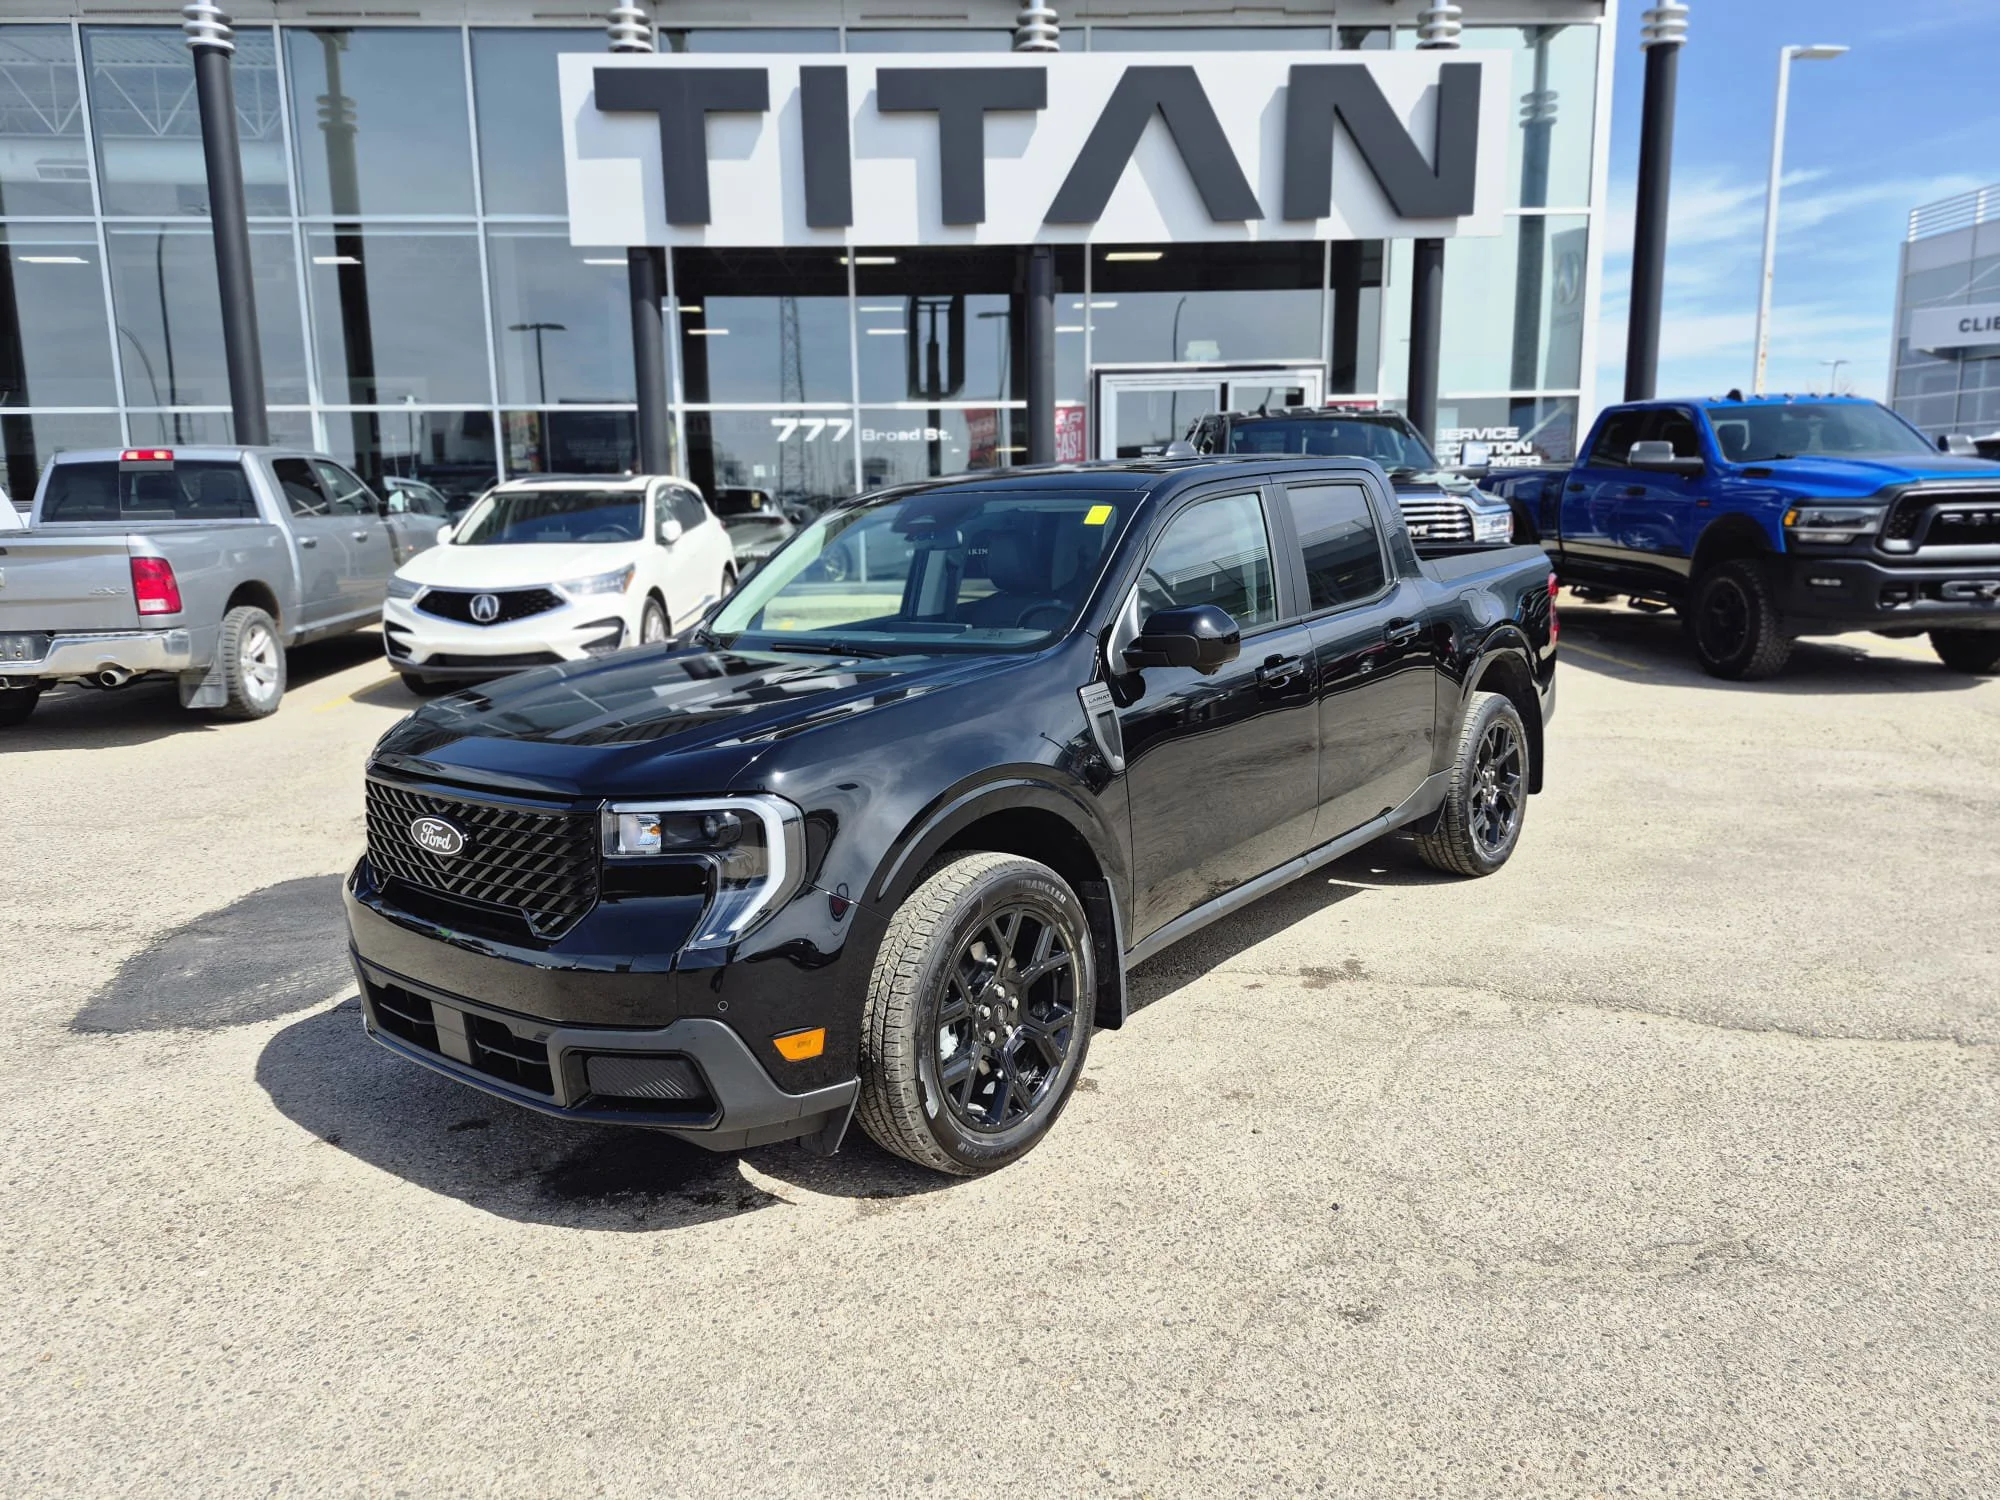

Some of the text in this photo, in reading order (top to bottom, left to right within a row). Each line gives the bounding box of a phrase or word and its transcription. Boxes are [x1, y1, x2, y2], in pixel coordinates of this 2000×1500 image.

[593, 62, 1482, 227] TITAN
[771, 418, 953, 442] 777 Broad St.
[420, 821, 452, 850] Ford
